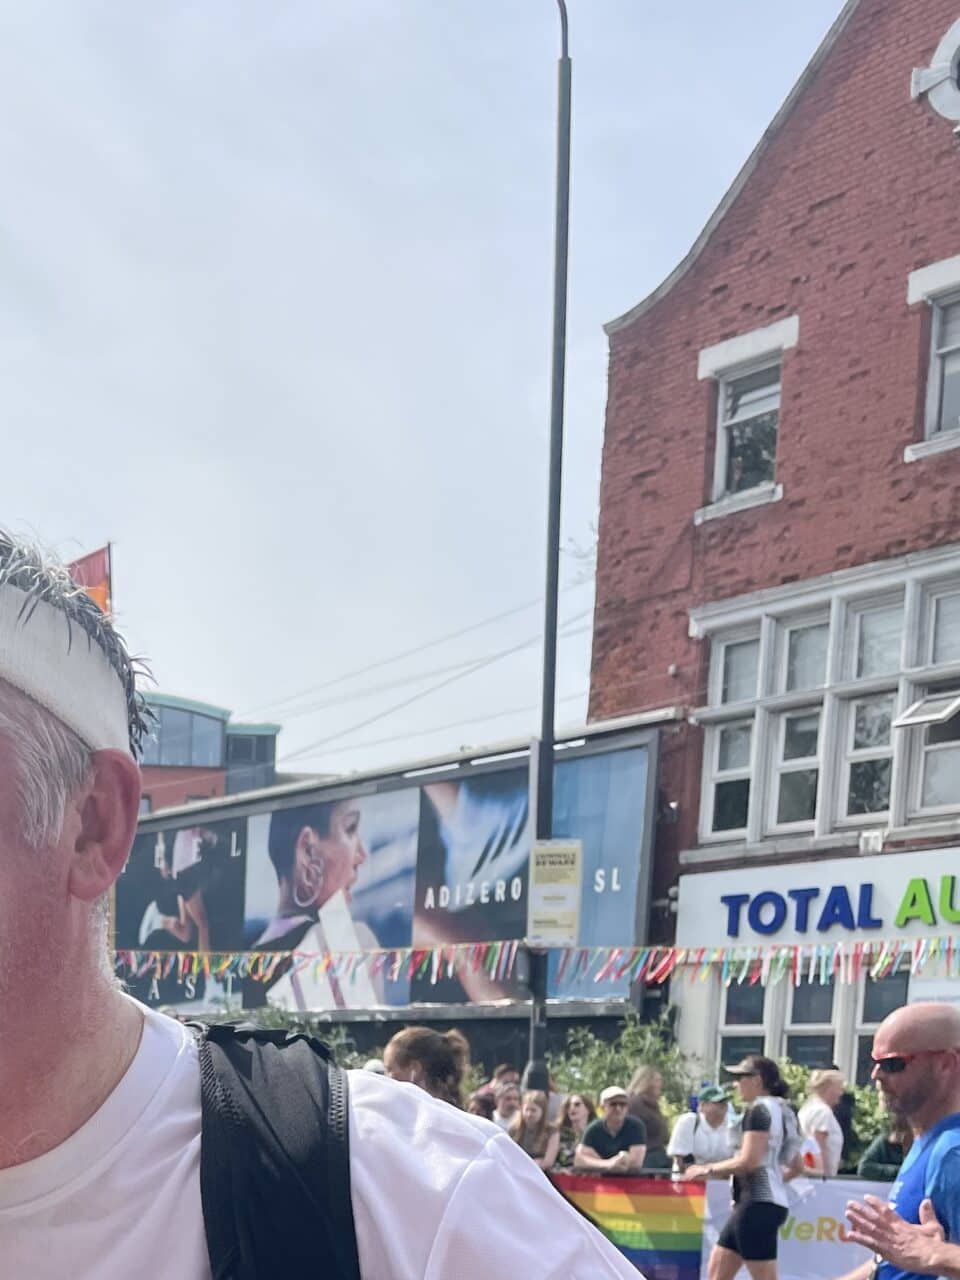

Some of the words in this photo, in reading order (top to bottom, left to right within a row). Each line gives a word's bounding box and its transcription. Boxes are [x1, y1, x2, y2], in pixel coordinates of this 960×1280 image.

[424, 877, 522, 909] ADIZERO
[594, 867, 621, 893] SL
[721, 883, 882, 938] TOTAL
